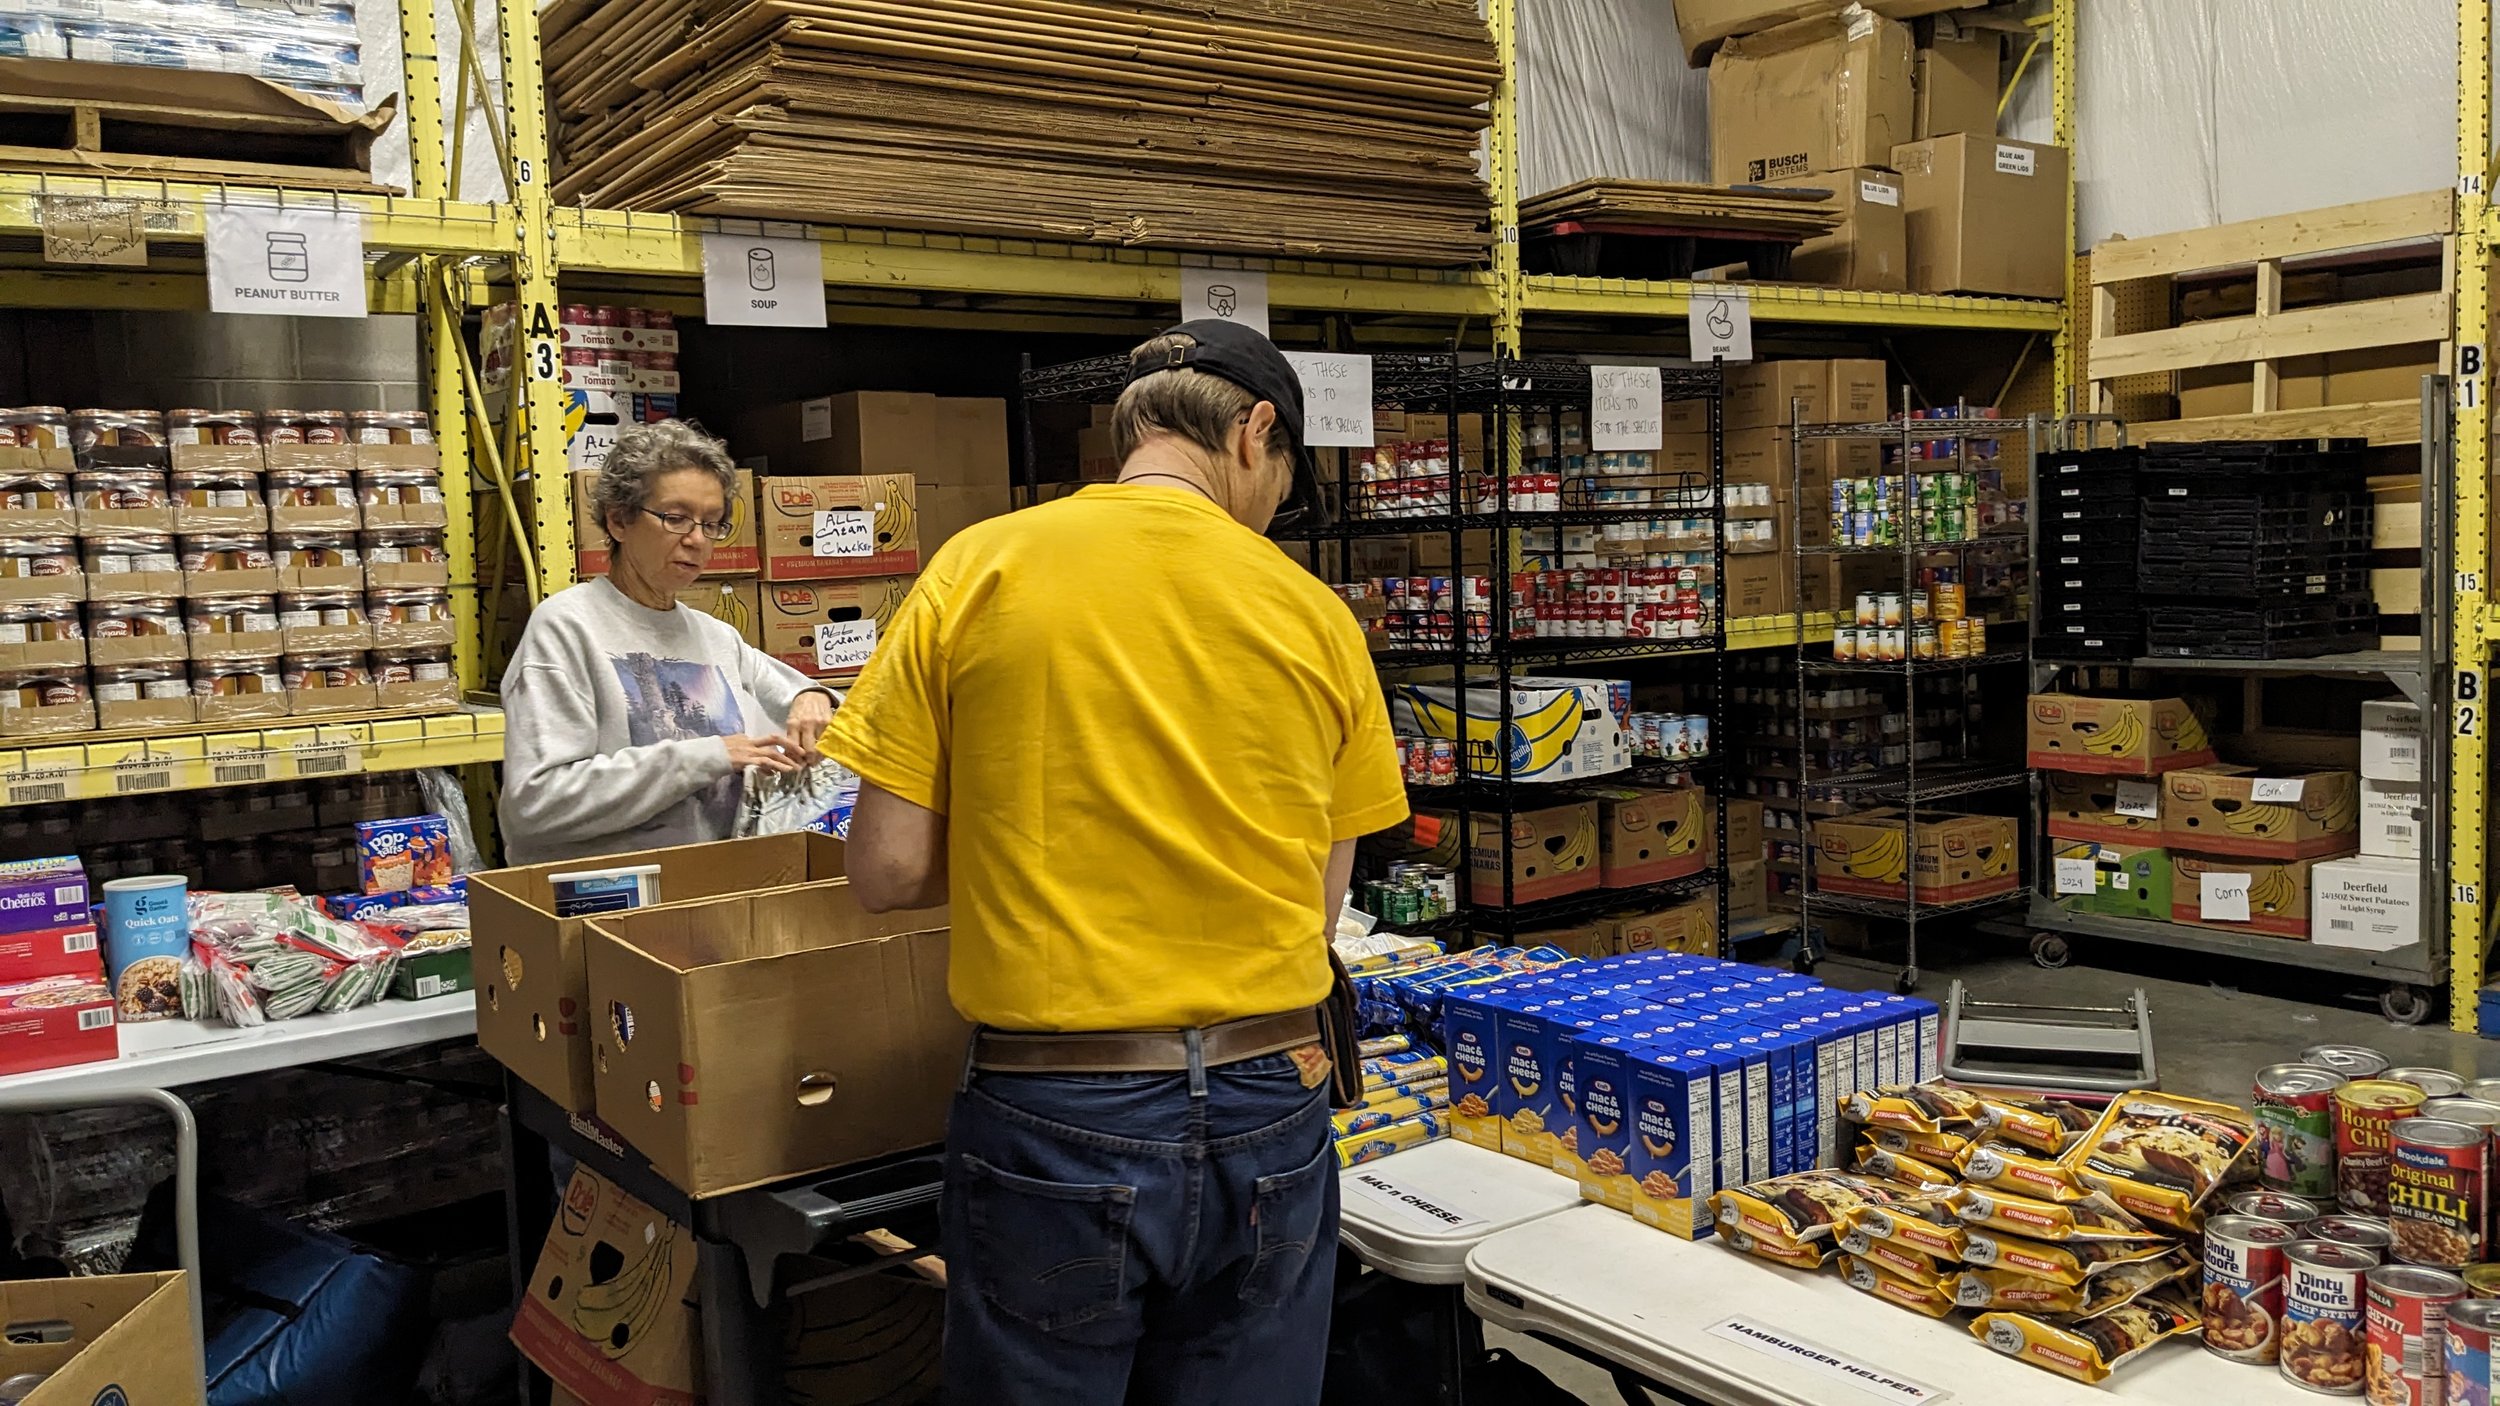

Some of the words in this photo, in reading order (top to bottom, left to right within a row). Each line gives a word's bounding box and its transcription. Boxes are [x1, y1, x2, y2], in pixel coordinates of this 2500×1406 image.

[1769, 153, 1808, 168] BUSCH
[1999, 151, 2013, 160] BLUE
[2013, 153, 2025, 161] AND
[520, 160, 531, 182] 6
[1769, 163, 1808, 177] SYSTEMS
[1998, 162, 2015, 171] GREEN
[2016, 164, 2029, 172] LIDS
[1864, 184, 1879, 193] BLUE
[1880, 186, 1889, 194] LIDS
[2462, 176, 2479, 193] 14
[1503, 227, 1516, 243] 10
[235, 287, 287, 299] PEANUT
[290, 289, 340, 301] BUTTER
[751, 299, 778, 310] SOUP
[530, 303, 555, 339] A
[581, 334, 615, 345] Tomato
[537, 343, 553, 379] 3
[2461, 346, 2480, 375] B
[1312, 361, 1348, 378] THESE
[583, 375, 616, 386] Tomato
[1596, 372, 1615, 389] USE
[1618, 370, 1651, 389] THESE
[1324, 387, 1336, 401] TO
[2464, 379, 2473, 407] 1
[1595, 396, 1621, 411] ITEMS
[1625, 397, 1639, 411] TO
[1320, 415, 1333, 431] THE
[1615, 419, 1630, 436] THE
[781, 491, 813, 504] Dole
[825, 513, 861, 525] ALL
[2459, 573, 2477, 590] 15
[779, 590, 811, 604] Dole
[821, 624, 853, 638] ALL
[2457, 672, 2478, 700] B
[2039, 705, 2062, 717] Dole
[2458, 707, 2474, 736] 2
[2177, 783, 2202, 795] Dole
[2383, 792, 2418, 801] Deerfield
[2343, 881, 2388, 894] Deerfield
[2458, 886, 2474, 903] 16
[0, 896, 46, 911] Cheerios
[2321, 891, 2348, 902] 24/15OZ
[2349, 894, 2373, 904] Sweet
[2374, 896, 2410, 907] Potatoes
[2340, 904, 2348, 912] in
[2348, 904, 2366, 914] Light
[2366, 906, 2386, 916] Syrup
[125, 917, 157, 929] Quick
[158, 914, 180, 925] Oats
[1632, 931, 1653, 944] Dole
[1457, 1043, 1475, 1055] mac
[1476, 1046, 1483, 1056] &
[1510, 1056, 1530, 1069] mac
[1530, 1060, 1538, 1071] &
[1589, 1091, 1611, 1107] mac
[1611, 1096, 1618, 1107] &
[1641, 1110, 1664, 1127] mac
[1665, 1116, 1673, 1129] &
[2010, 1122, 2048, 1140] STROGANOFF
[2343, 1156, 2366, 1169] Chunky
[2365, 1157, 2383, 1167] Beef
[2397, 1148, 2445, 1167] Brookdale
[2391, 1163, 2455, 1191] Original
[1357, 1175, 1392, 1191] MAC
[1388, 1189, 1402, 1197] n
[572, 1178, 594, 1212] Dole
[2388, 1182, 2468, 1222] CHILI
[2126, 1197, 2172, 1216] STROGANOFF
[2391, 1205, 2412, 1218] WITH
[2414, 1211, 2456, 1227] BEANS
[1746, 1217, 1778, 1234] STROGANOFF
[1906, 1229, 1949, 1249] STROGANOFF
[1762, 1244, 1801, 1257] STROGANOFF
[2205, 1236, 2236, 1263] Dinty
[1880, 1249, 1919, 1269] STROGANOFF
[2011, 1254, 2055, 1271] STROGANOFF
[2222, 1272, 2251, 1289] STEW
[2299, 1271, 2344, 1294] Dinty
[1886, 1284, 1926, 1302] STROGANOFF
[2007, 1290, 2051, 1300] STROGANOFF
[2296, 1284, 2349, 1305] Moore
[2288, 1297, 2316, 1315] BEEF
[2317, 1307, 2359, 1320] STEW
[1727, 1322, 1841, 1367] HAMBURGER
[2036, 1346, 2082, 1367] STROGANOFF
